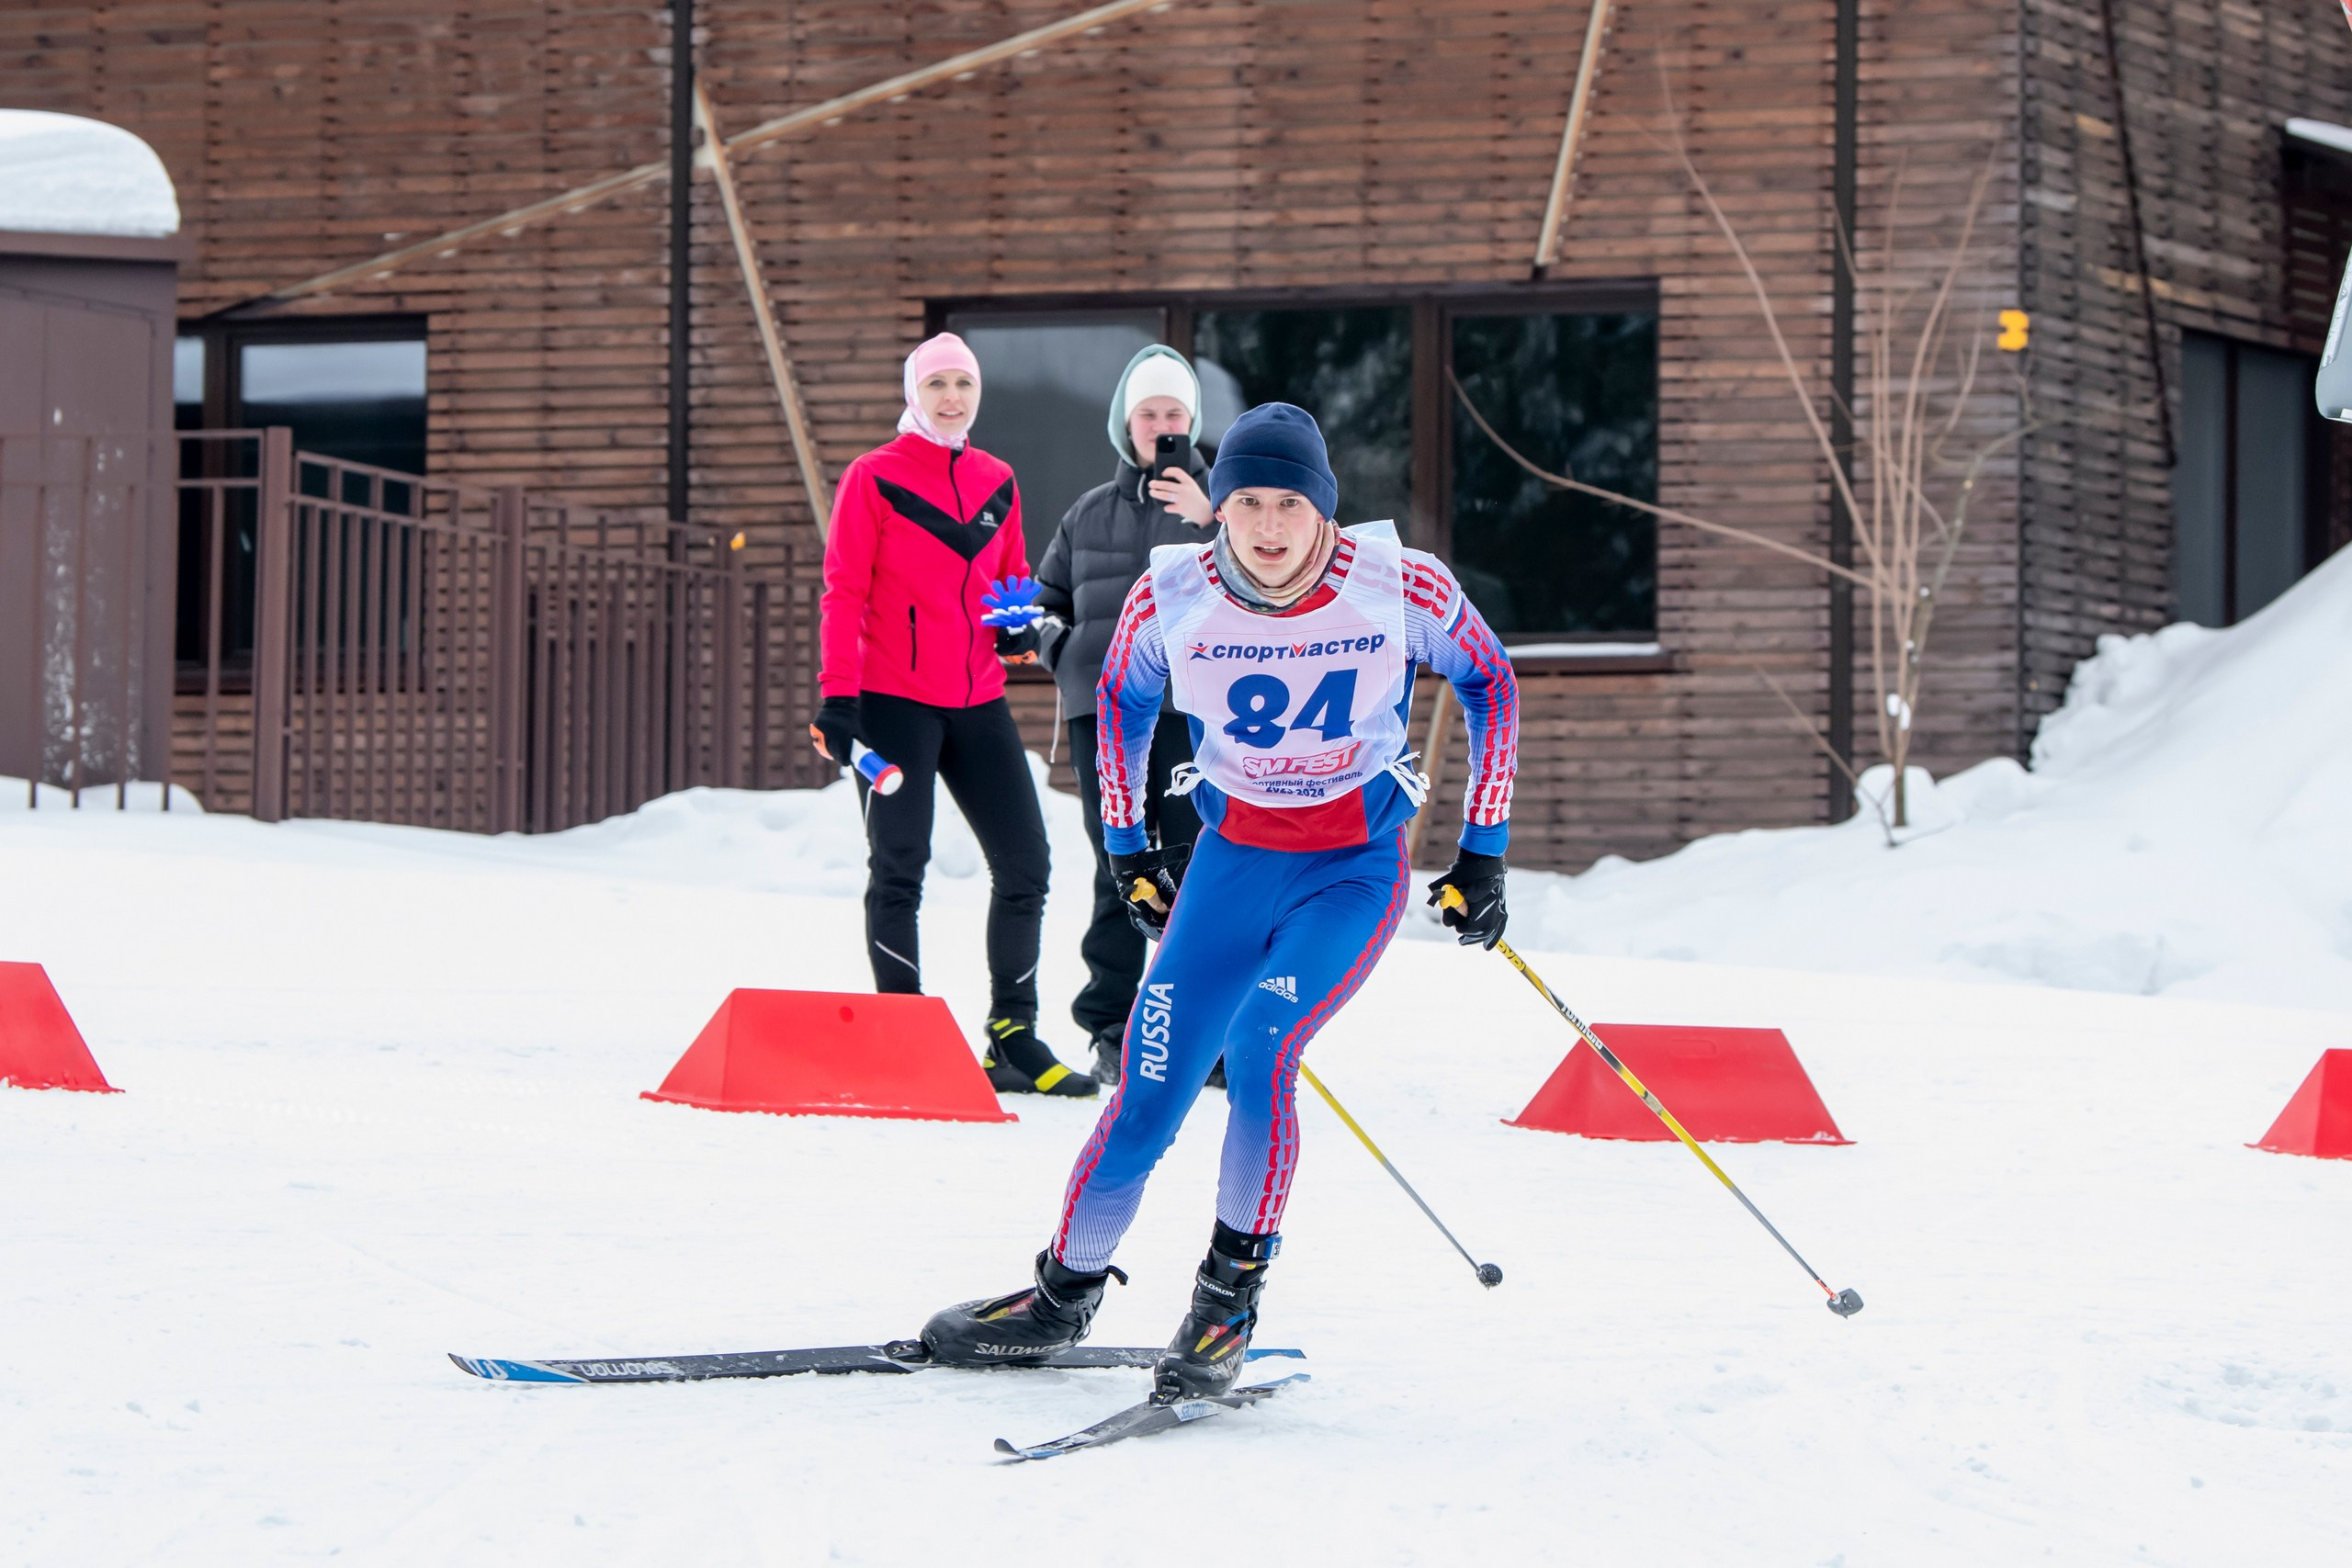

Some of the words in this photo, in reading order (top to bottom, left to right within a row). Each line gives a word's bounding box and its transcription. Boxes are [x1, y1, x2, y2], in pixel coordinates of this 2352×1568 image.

[1223, 668, 1359, 750] 84
[1306, 772, 1363, 788] фестиваль
[1258, 981, 1299, 1004] adidas
[1139, 983, 1175, 1083] RUSSIA
[1197, 1274, 1236, 1298] SALOMON
[975, 1340, 1071, 1357] SALOMO
